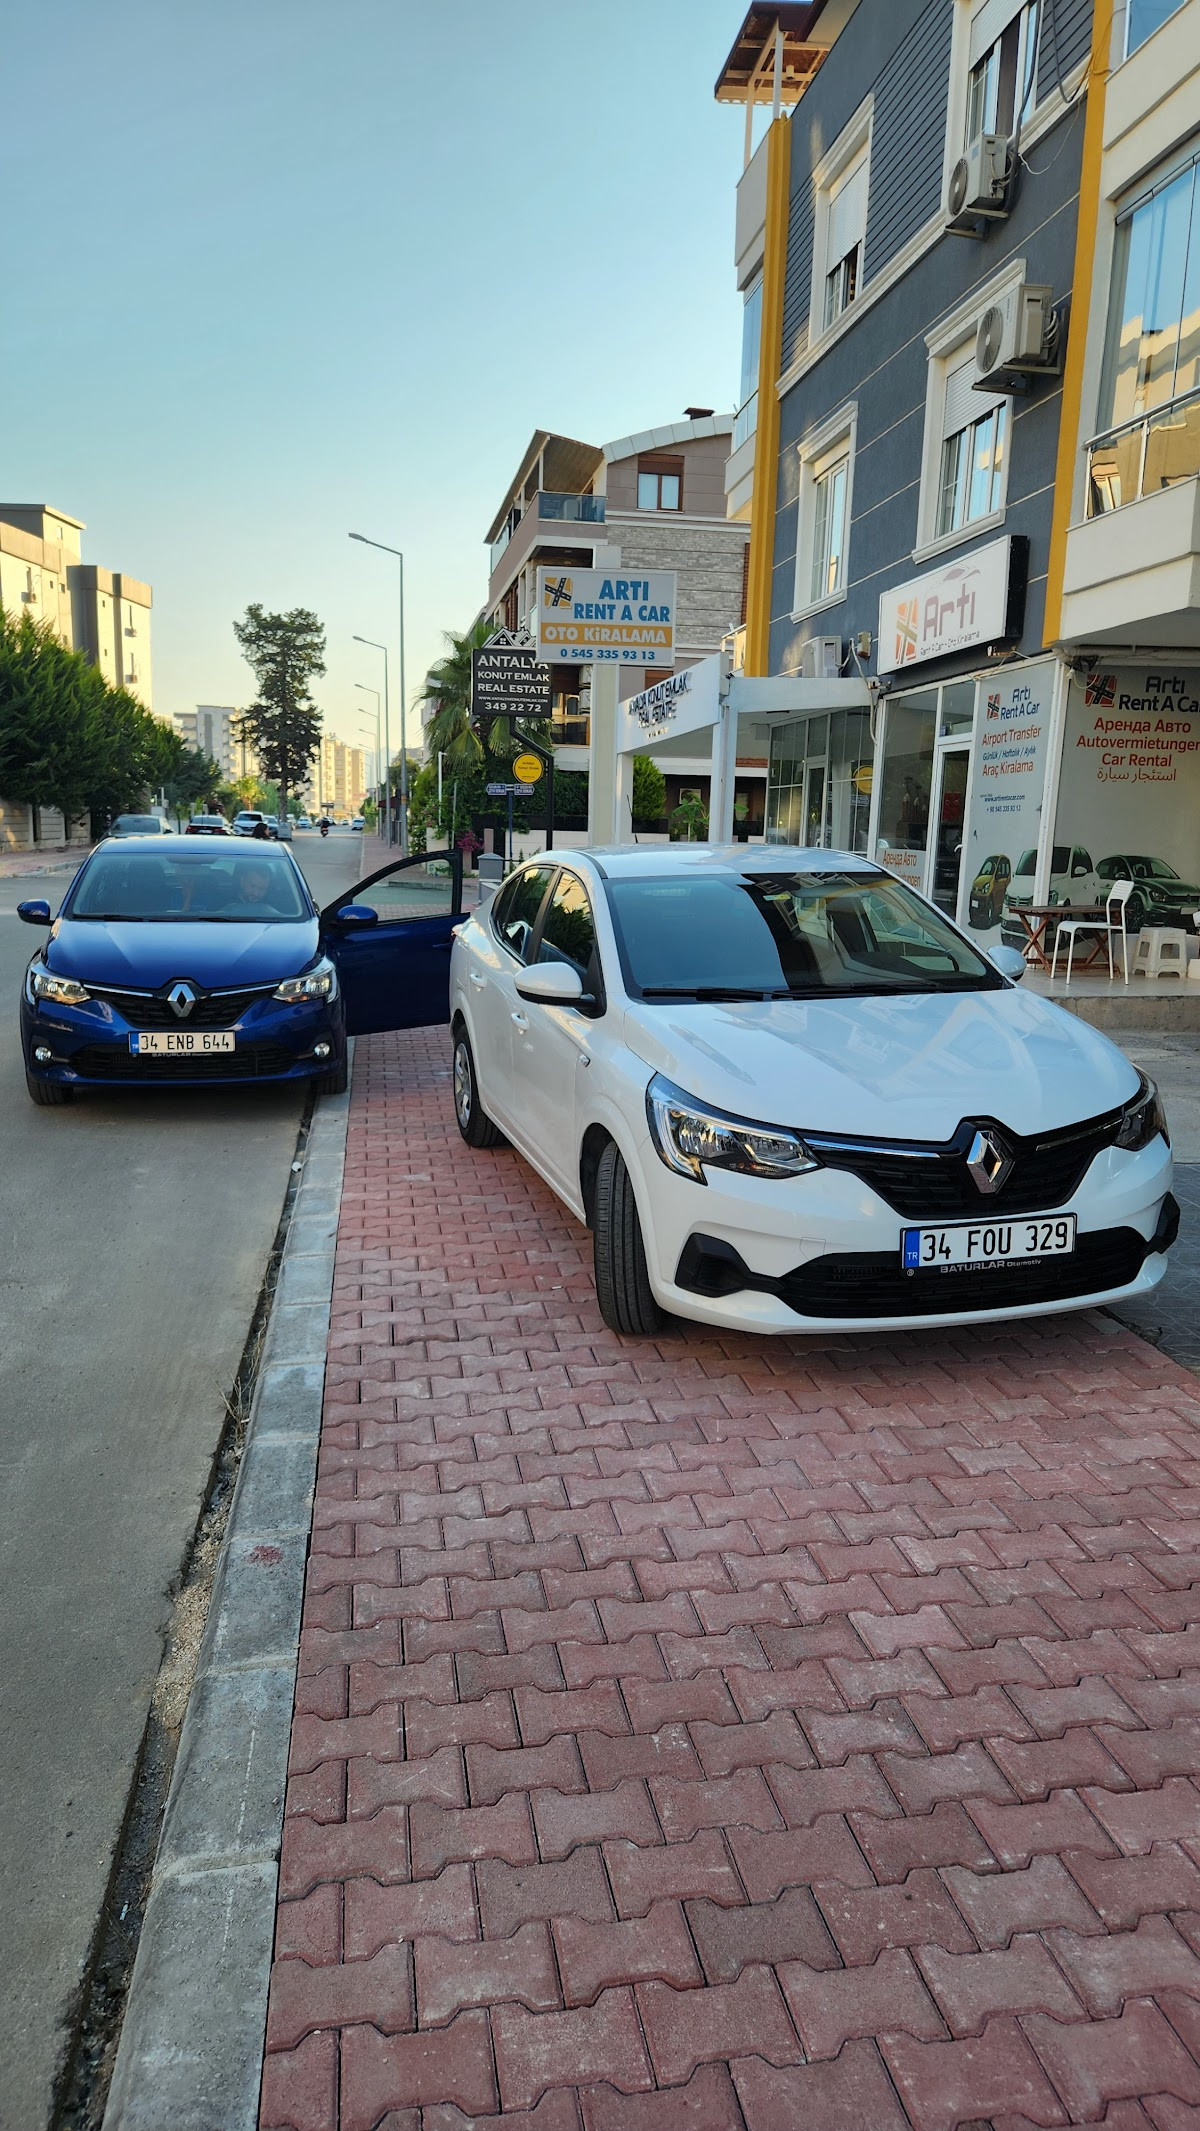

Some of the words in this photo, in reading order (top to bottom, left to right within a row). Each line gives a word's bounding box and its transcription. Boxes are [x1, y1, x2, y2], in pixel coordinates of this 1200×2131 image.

[598, 579, 649, 601] ARTI
[574, 603, 616, 620] RENT
[620, 605, 633, 620] A
[638, 605, 670, 622] CAR
[545, 626, 579, 641] OTO
[560, 648, 568, 657] 0
[571, 649, 593, 658] 545
[597, 650, 619, 659] 335
[622, 651, 637, 659] 93
[641, 651, 655, 660] 13
[477, 671, 513, 680] KONUT
[514, 672, 550, 682] EMLAK
[477, 683, 508, 692] REAL
[509, 685, 550, 695] ESTATE
[484, 702, 507, 710] 349
[509, 703, 525, 711] 22
[526, 704, 542, 712] 72
[1000, 704, 1018, 720] Rent
[1019, 703, 1025, 717] A
[1026, 701, 1040, 716] Car
[1118, 694, 1160, 711] Rent
[1160, 696, 1175, 711] A
[1177, 696, 1200, 713] Ca
[1094, 717, 1151, 734] Аренда
[1154, 719, 1191, 733] Авто
[982, 730, 1008, 747] Airport
[1009, 724, 1042, 742] Transfer
[1102, 753, 1126, 766] Car
[1128, 754, 1172, 767] Rental
[982, 764, 999, 778] Araç
[1000, 760, 1034, 774] Kiralama
[167, 1034, 194, 1050] ENB
[202, 1034, 230, 1050] 644
[922, 1232, 951, 1262] 34
[967, 1226, 1012, 1258] FOU
[1025, 1221, 1068, 1252] 329
[906, 1251, 918, 1261] TR
[940, 1260, 1005, 1274] BATURLAR
[1006, 1258, 1042, 1267] Otomotiv
